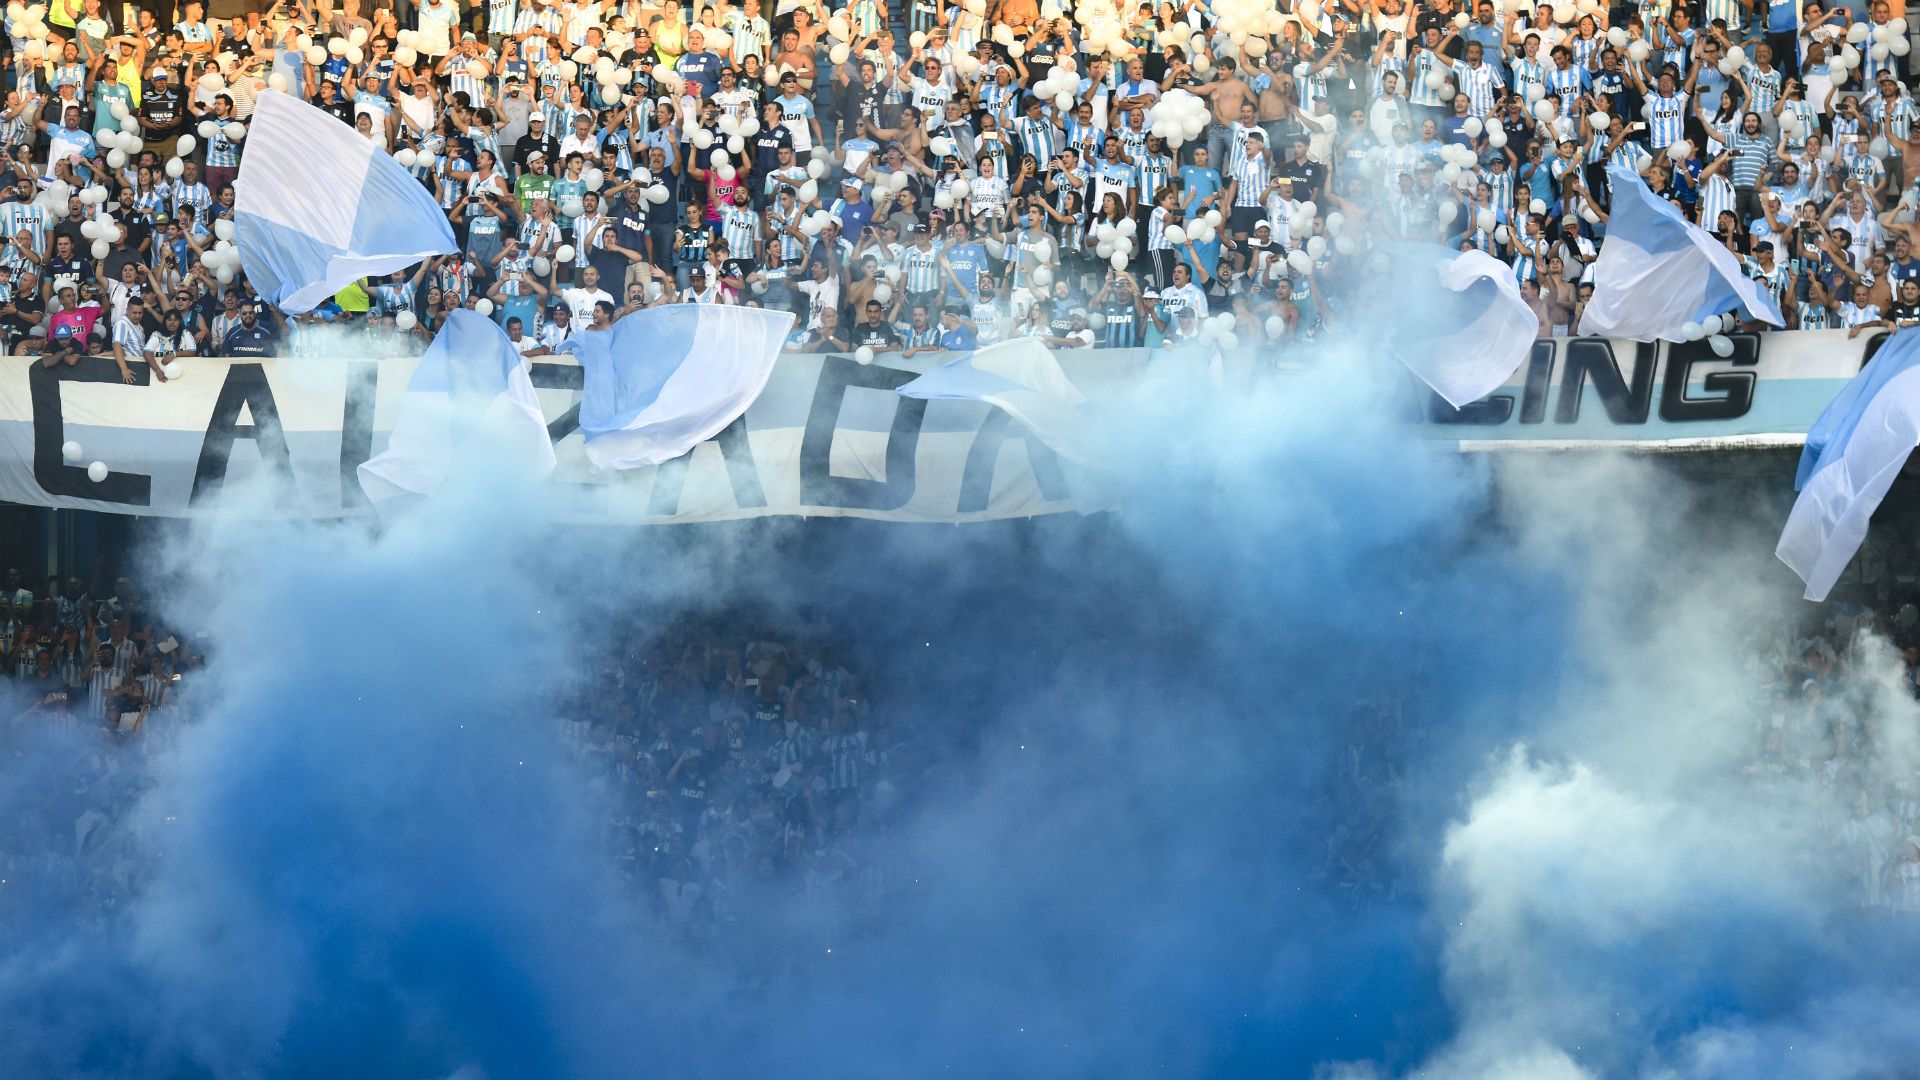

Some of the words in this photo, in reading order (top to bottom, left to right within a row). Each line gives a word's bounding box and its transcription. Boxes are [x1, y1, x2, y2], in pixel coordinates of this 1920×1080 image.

[681, 64, 704, 72] RCA
[1751, 77, 1774, 90] RCA
[1556, 86, 1578, 96] RCA
[1601, 84, 1622, 93] RCA
[921, 97, 943, 106] RCA
[1656, 110, 1677, 119] RCA
[1798, 113, 1810, 122] CA
[1028, 123, 1049, 134] RCA
[758, 139, 778, 147] RCA
[1144, 166, 1166, 174] RCA
[1849, 166, 1872, 177] RCA
[1103, 176, 1122, 186] RCA
[16, 218, 39, 226] RCA
[623, 217, 645, 231] RCA
[730, 218, 751, 230] RCA
[474, 226, 495, 234] RCA
[910, 260, 934, 269] RCA
[55, 272, 79, 281] RCA
[1163, 299, 1186, 307] RCA
[1108, 315, 1132, 323] RCA
[1803, 315, 1825, 323] RCA
[72, 326, 85, 335] CA
